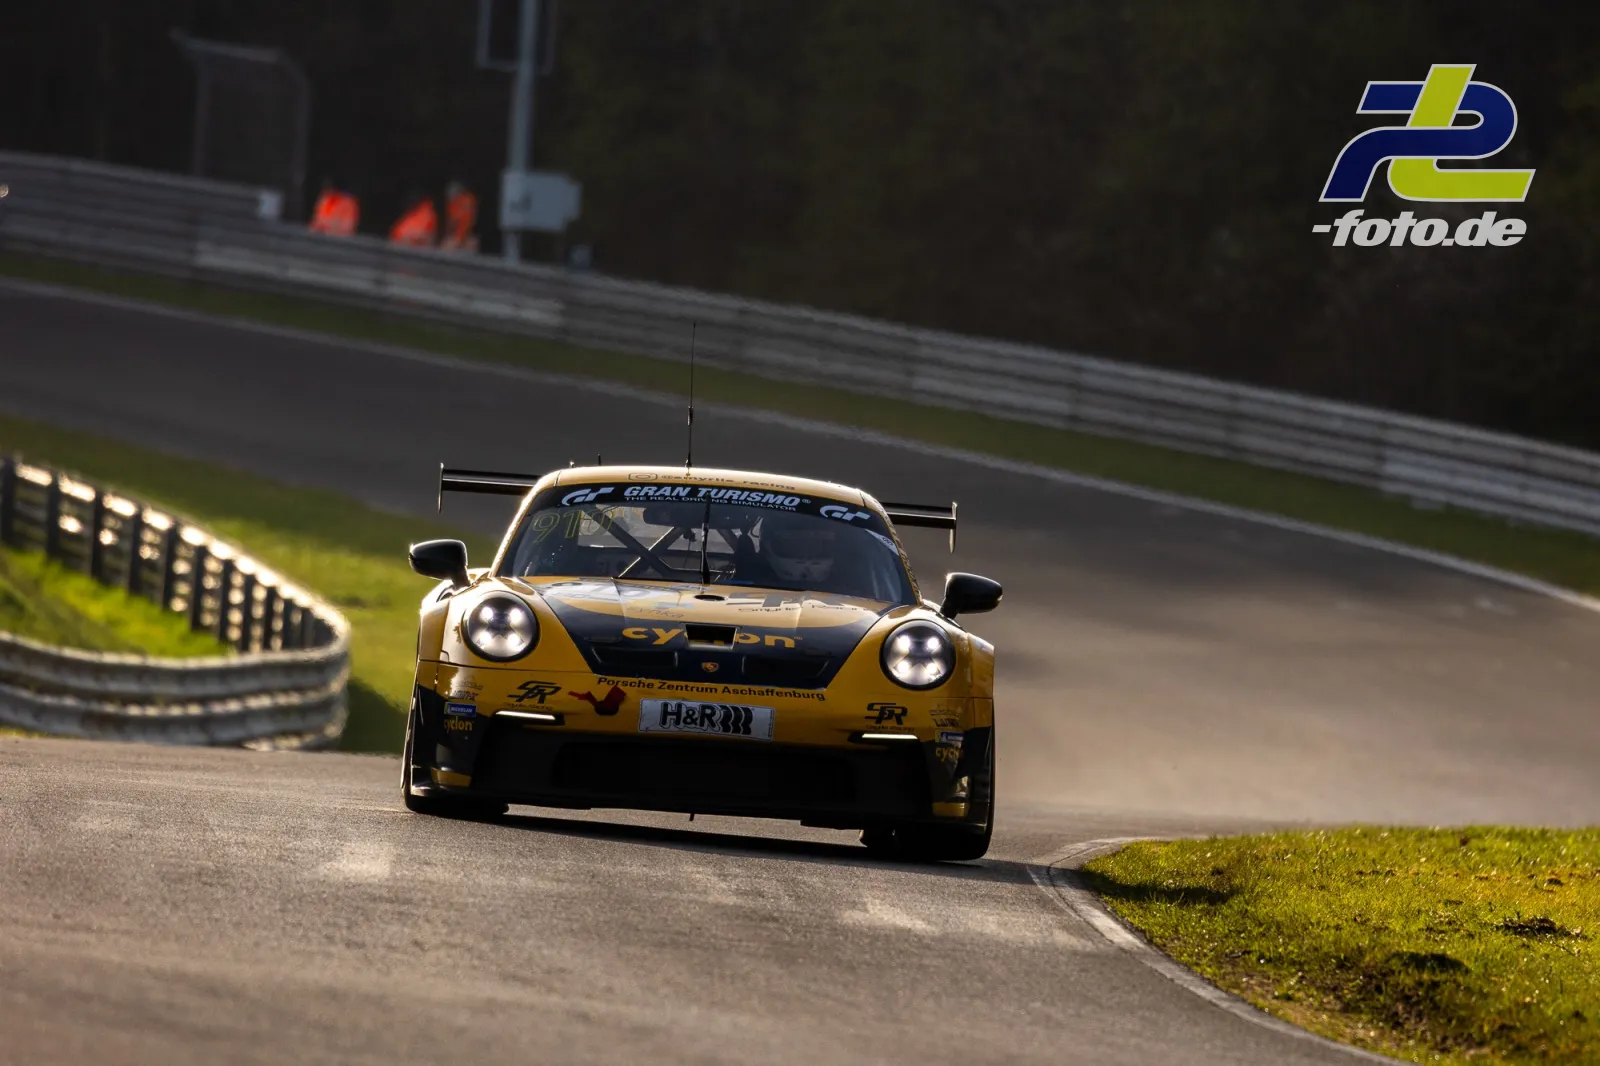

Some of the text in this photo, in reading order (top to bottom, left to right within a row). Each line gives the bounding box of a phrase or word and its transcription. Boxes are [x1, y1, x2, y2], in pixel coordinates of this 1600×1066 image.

[623, 485, 691, 497] GRAN
[681, 497, 730, 505] DRIVNG
[732, 499, 797, 512] SIMULATOR
[597, 677, 826, 702] Porsche Zentrum Aschaffenburg
